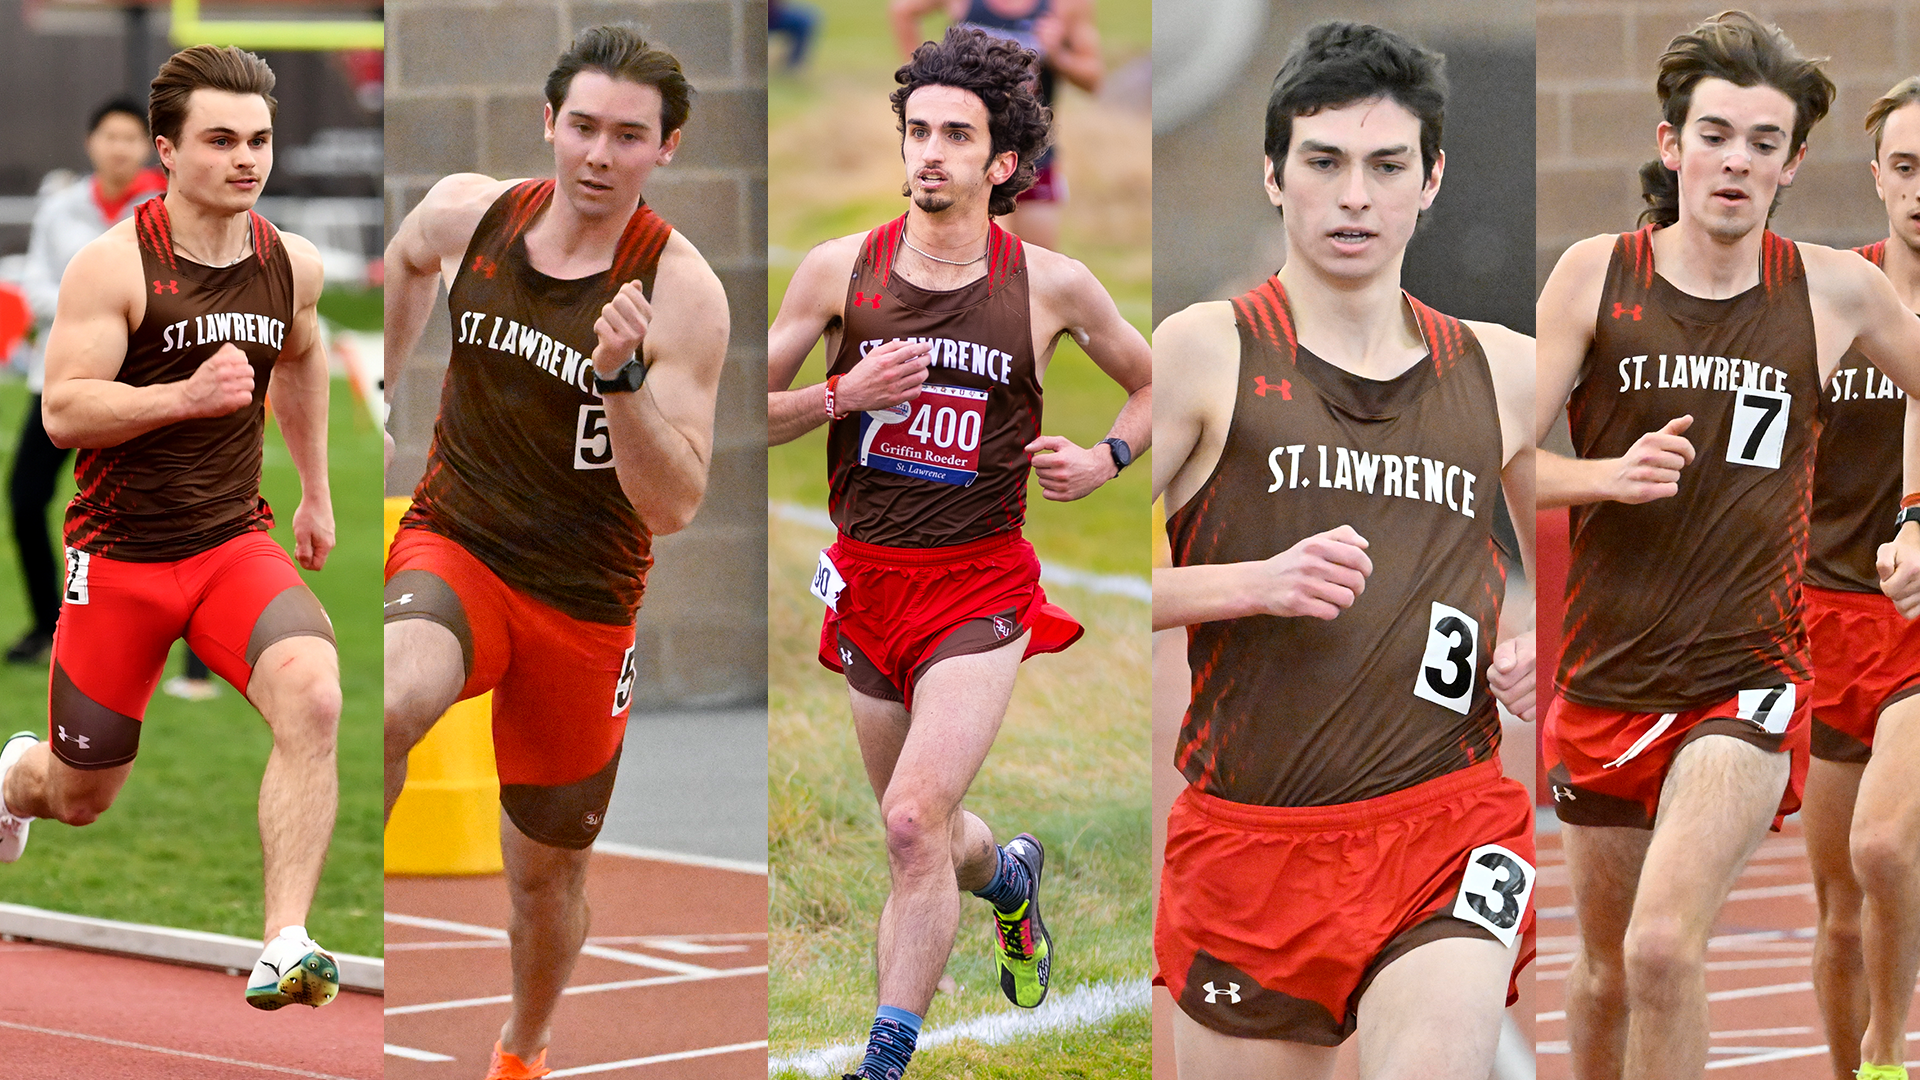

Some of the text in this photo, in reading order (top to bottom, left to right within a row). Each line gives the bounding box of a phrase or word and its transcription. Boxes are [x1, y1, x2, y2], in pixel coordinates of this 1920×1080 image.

[162, 312, 285, 353] ST. LAWRENCE
[458, 311, 483, 346] ST.
[892, 337, 1013, 385] WRENCE
[1618, 354, 1788, 394] ST. LAWRENCE
[1831, 368, 1859, 403] ST.
[580, 409, 613, 465] 5
[908, 403, 981, 452] 400
[1741, 394, 1782, 460] 7
[880, 442, 968, 467] Griffin Roeder
[895, 462, 947, 480] St. Lawrence
[1268, 444, 1477, 519] ST. LAWRENCE
[1425, 616, 1473, 699] 3
[1465, 852, 1527, 929] 3
